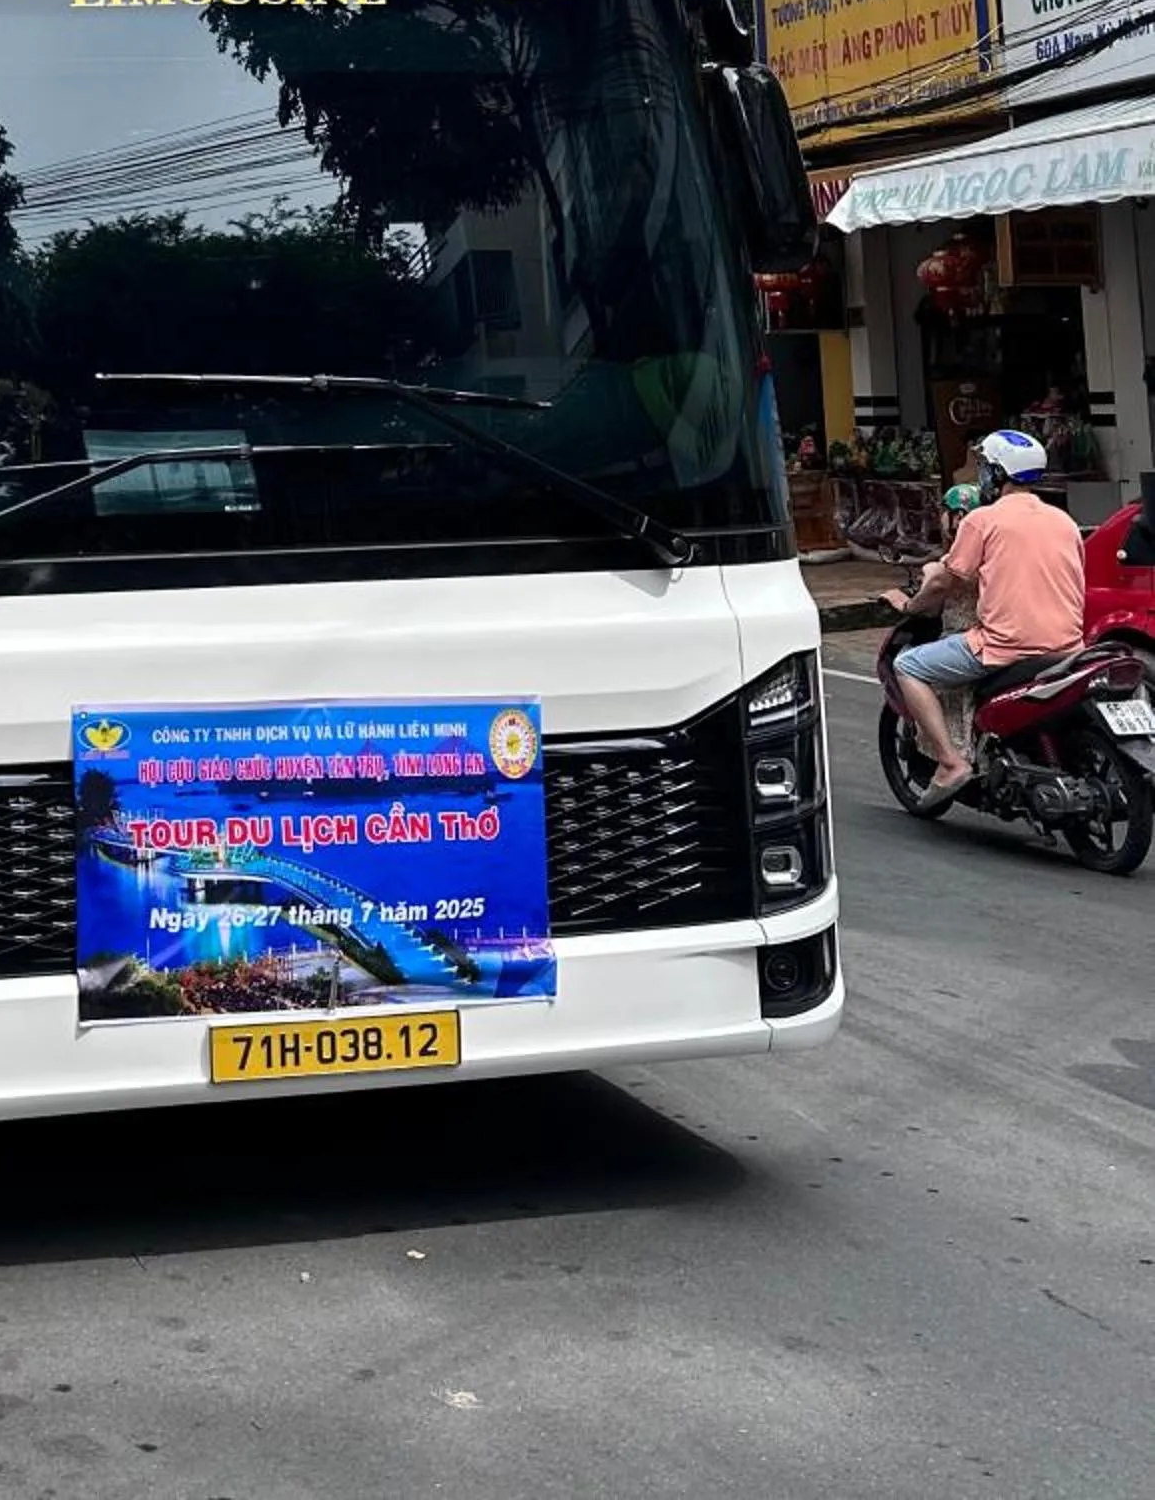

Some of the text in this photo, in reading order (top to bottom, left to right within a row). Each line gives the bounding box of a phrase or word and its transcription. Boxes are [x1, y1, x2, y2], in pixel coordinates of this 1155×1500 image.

[874, 12, 926, 56] PHONG
[152, 725, 190, 744] CÔNG
[195, 727, 213, 742] TY
[215, 726, 252, 742] TNHH
[256, 725, 288, 744] DỊCH
[292, 724, 312, 743] VỤ
[315, 719, 333, 740] VÀ
[358, 719, 395, 739] HÀNH
[399, 719, 430, 739] LIÊN
[138, 756, 164, 788] HỘI
[128, 820, 223, 851] TOUR
[227, 816, 272, 847] DU
[282, 813, 359, 853] LỊCH
[365, 802, 433, 844] CẦN
[150, 897, 485, 933] Ngày 26-27 tháng 7 năm 2025
[233, 1023, 439, 1071] 71H-038.12
